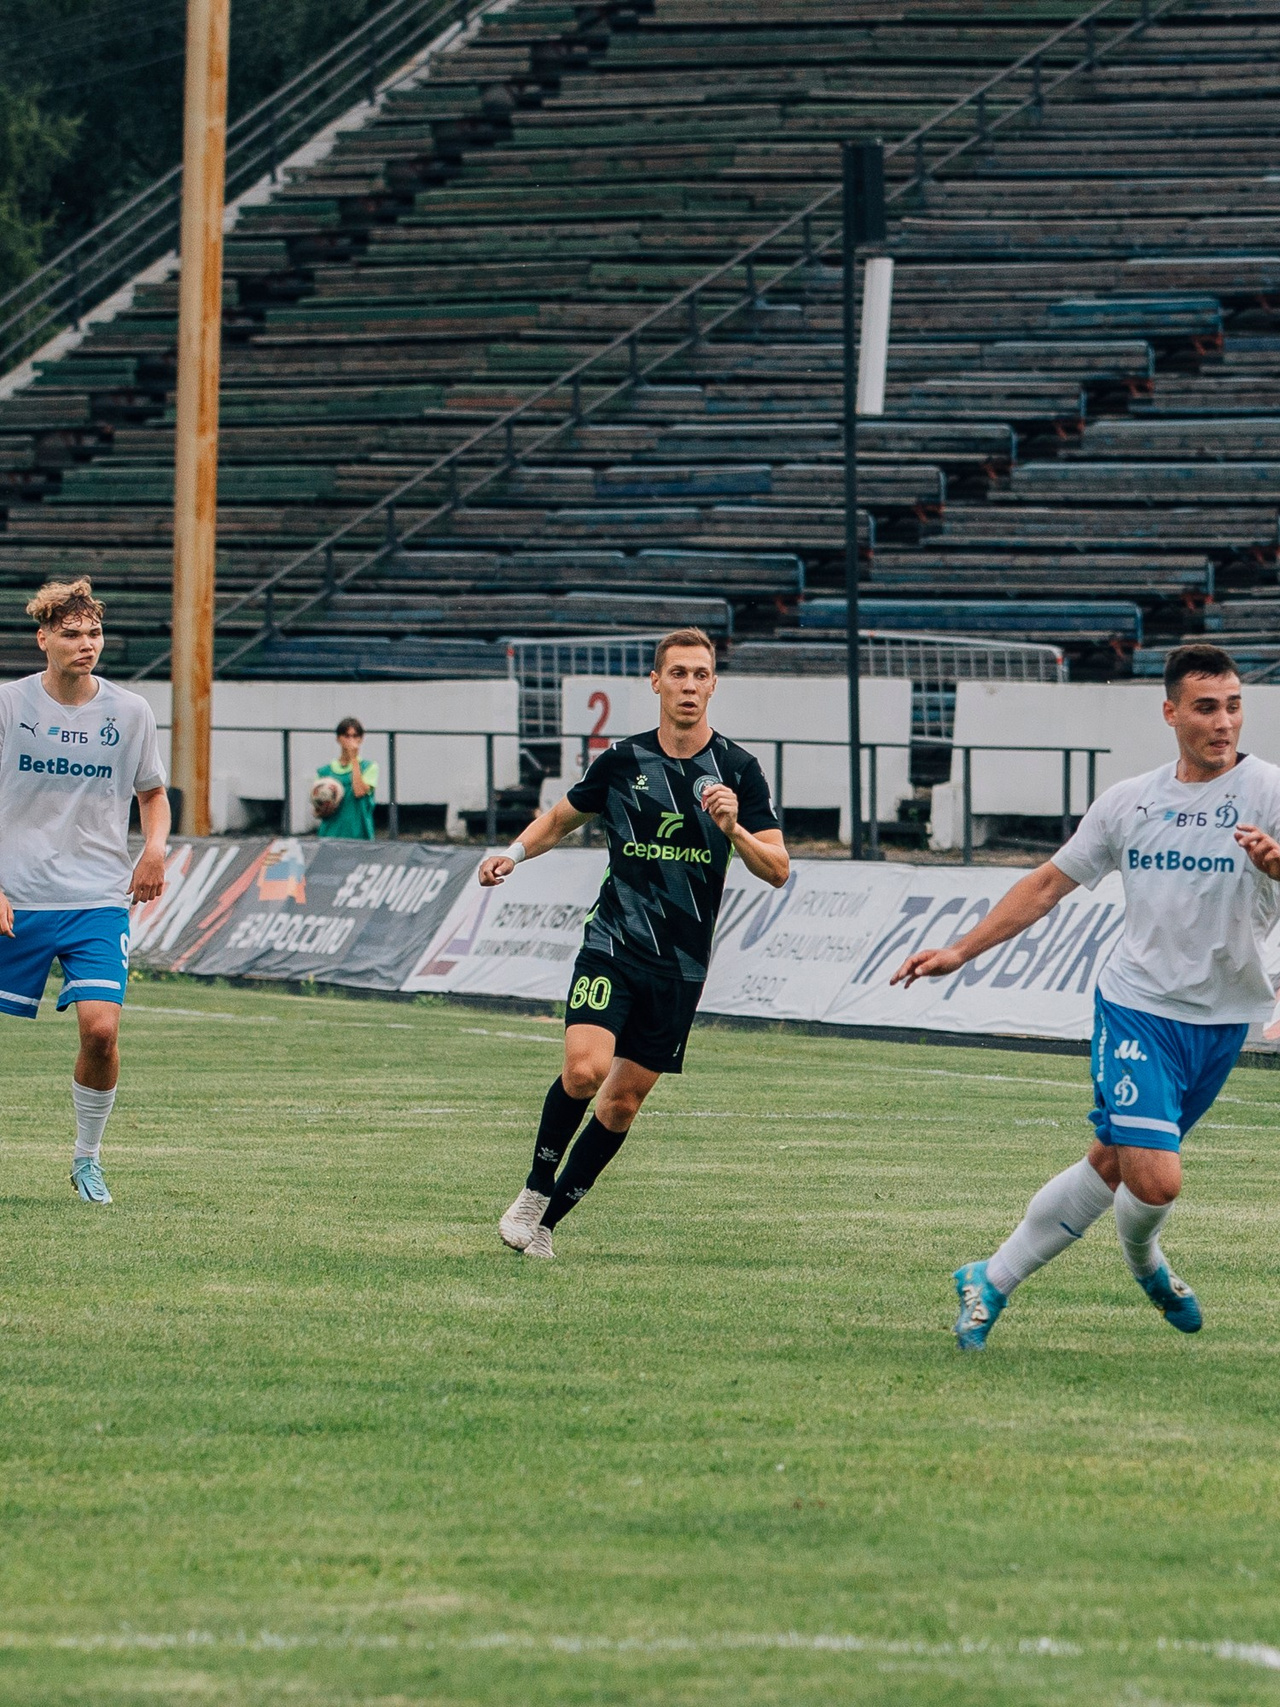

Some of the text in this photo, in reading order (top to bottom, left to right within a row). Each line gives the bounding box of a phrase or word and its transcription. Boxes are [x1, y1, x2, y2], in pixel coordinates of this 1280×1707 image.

[588, 691, 610, 748] 2
[61, 730, 88, 744] ВТБ
[18, 754, 113, 778] BetBoom
[1176, 812, 1207, 827] ВТБ
[1128, 849, 1235, 873] BetBoom
[331, 863, 449, 913] #ЗАМИР
[570, 976, 612, 1010] 80
